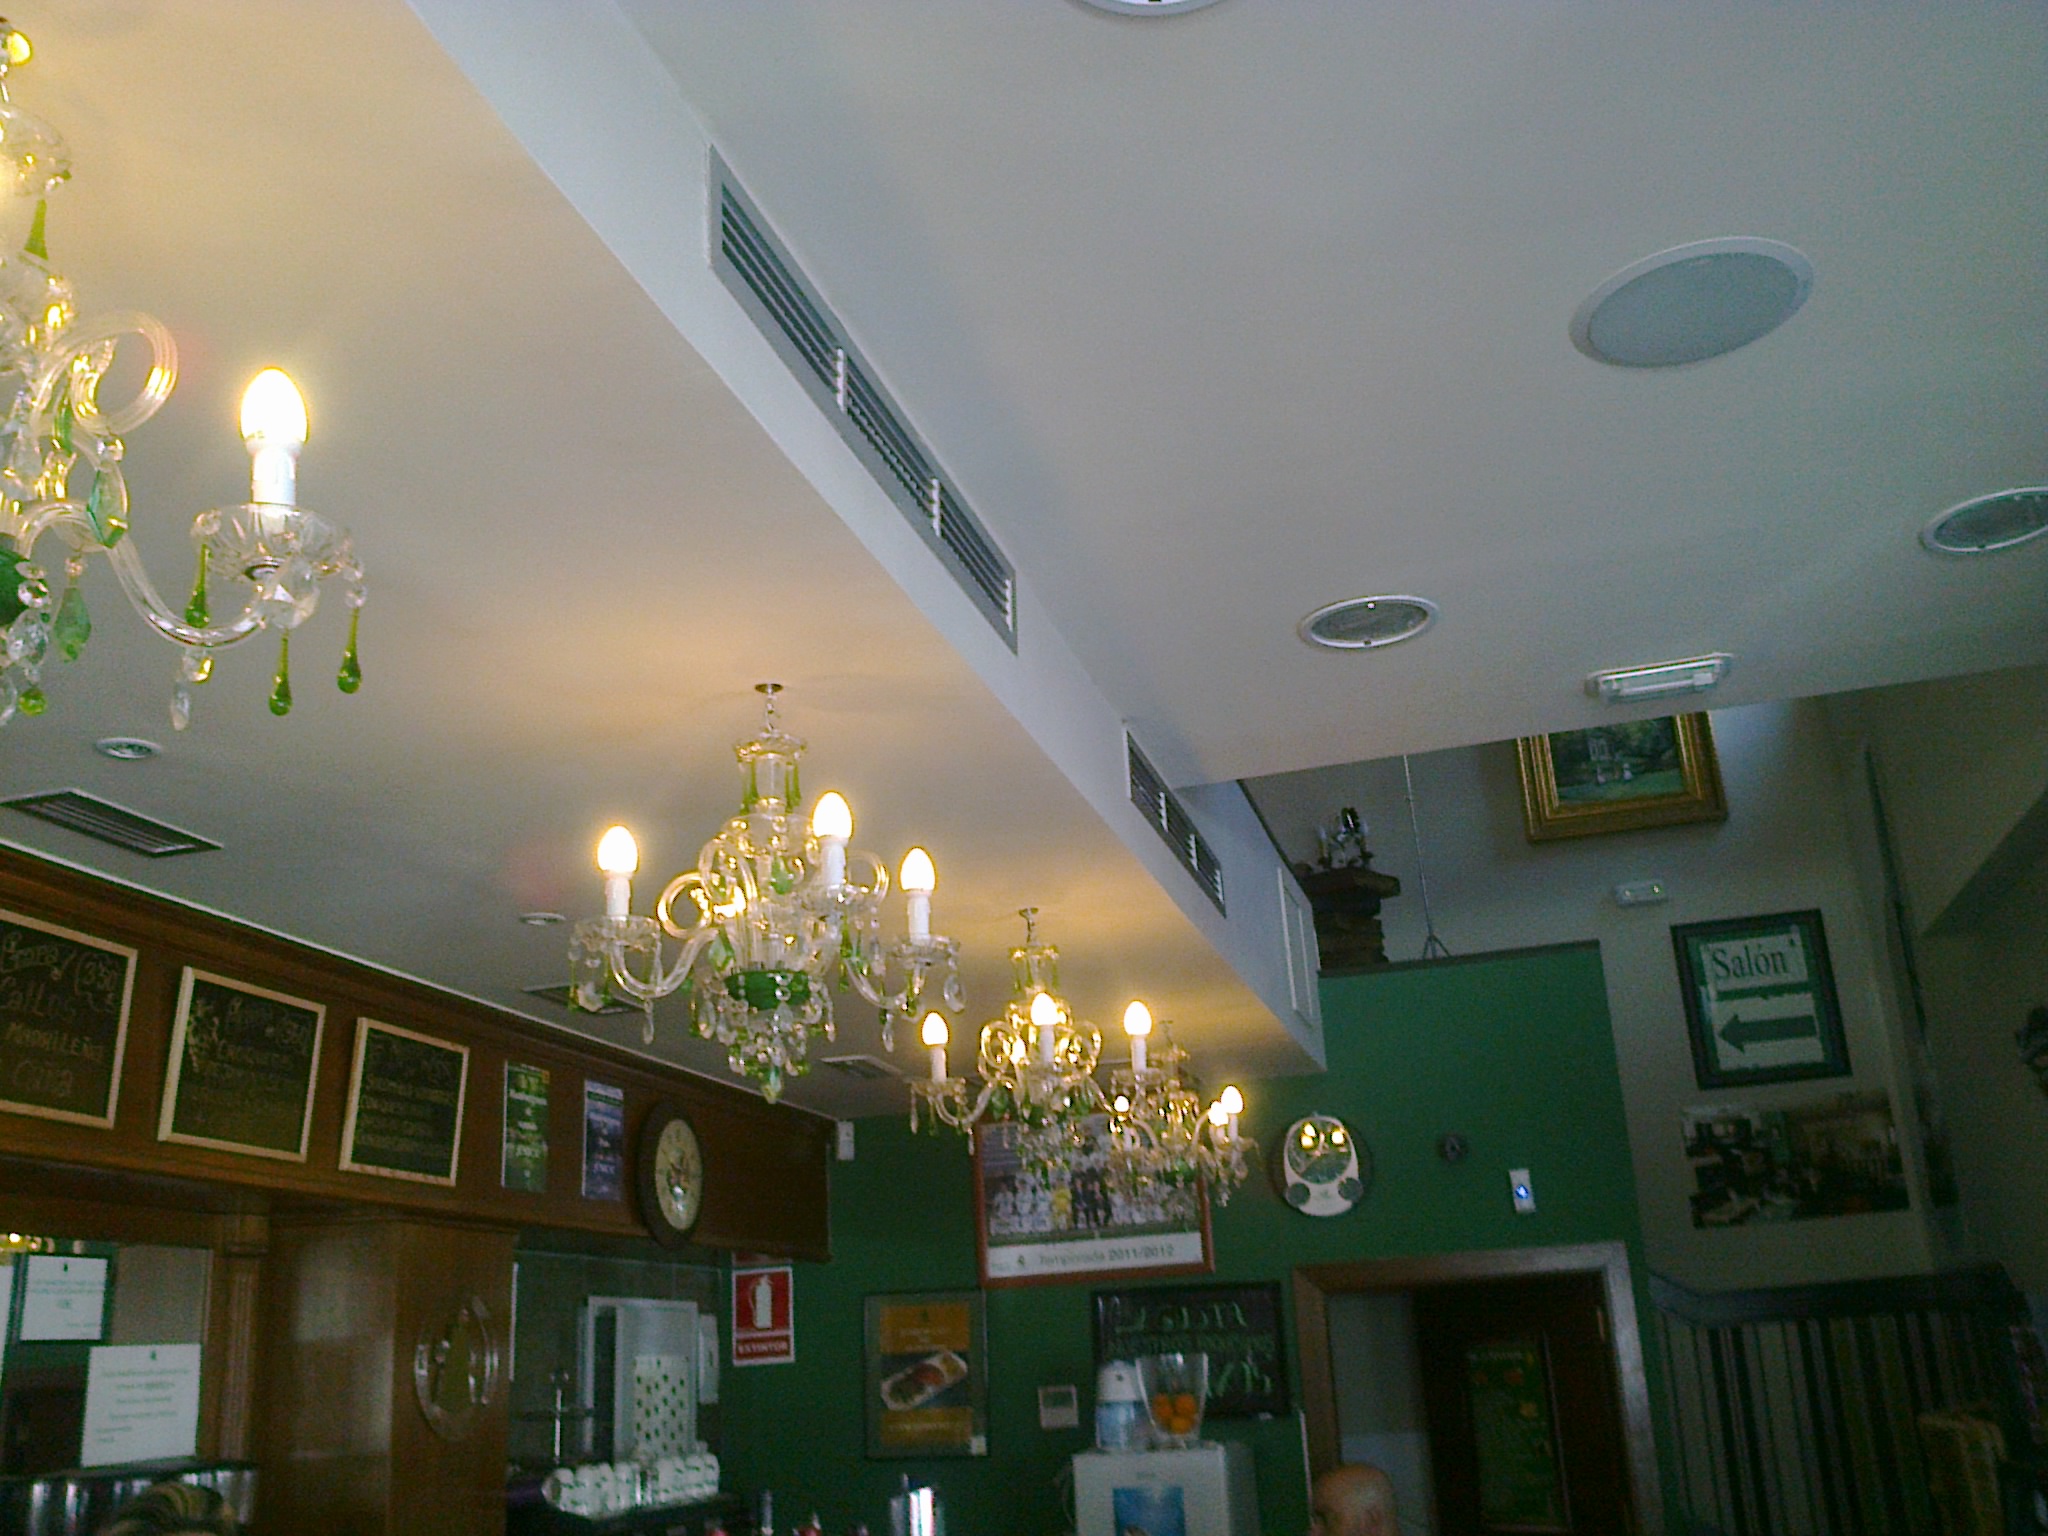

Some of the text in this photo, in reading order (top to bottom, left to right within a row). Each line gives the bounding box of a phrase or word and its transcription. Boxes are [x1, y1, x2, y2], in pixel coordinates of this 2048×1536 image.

[1711, 943, 1790, 980] Salón
[1107, 1243, 1175, 1263] 2011/2012
[737, 1340, 788, 1355] EXTINTOR
